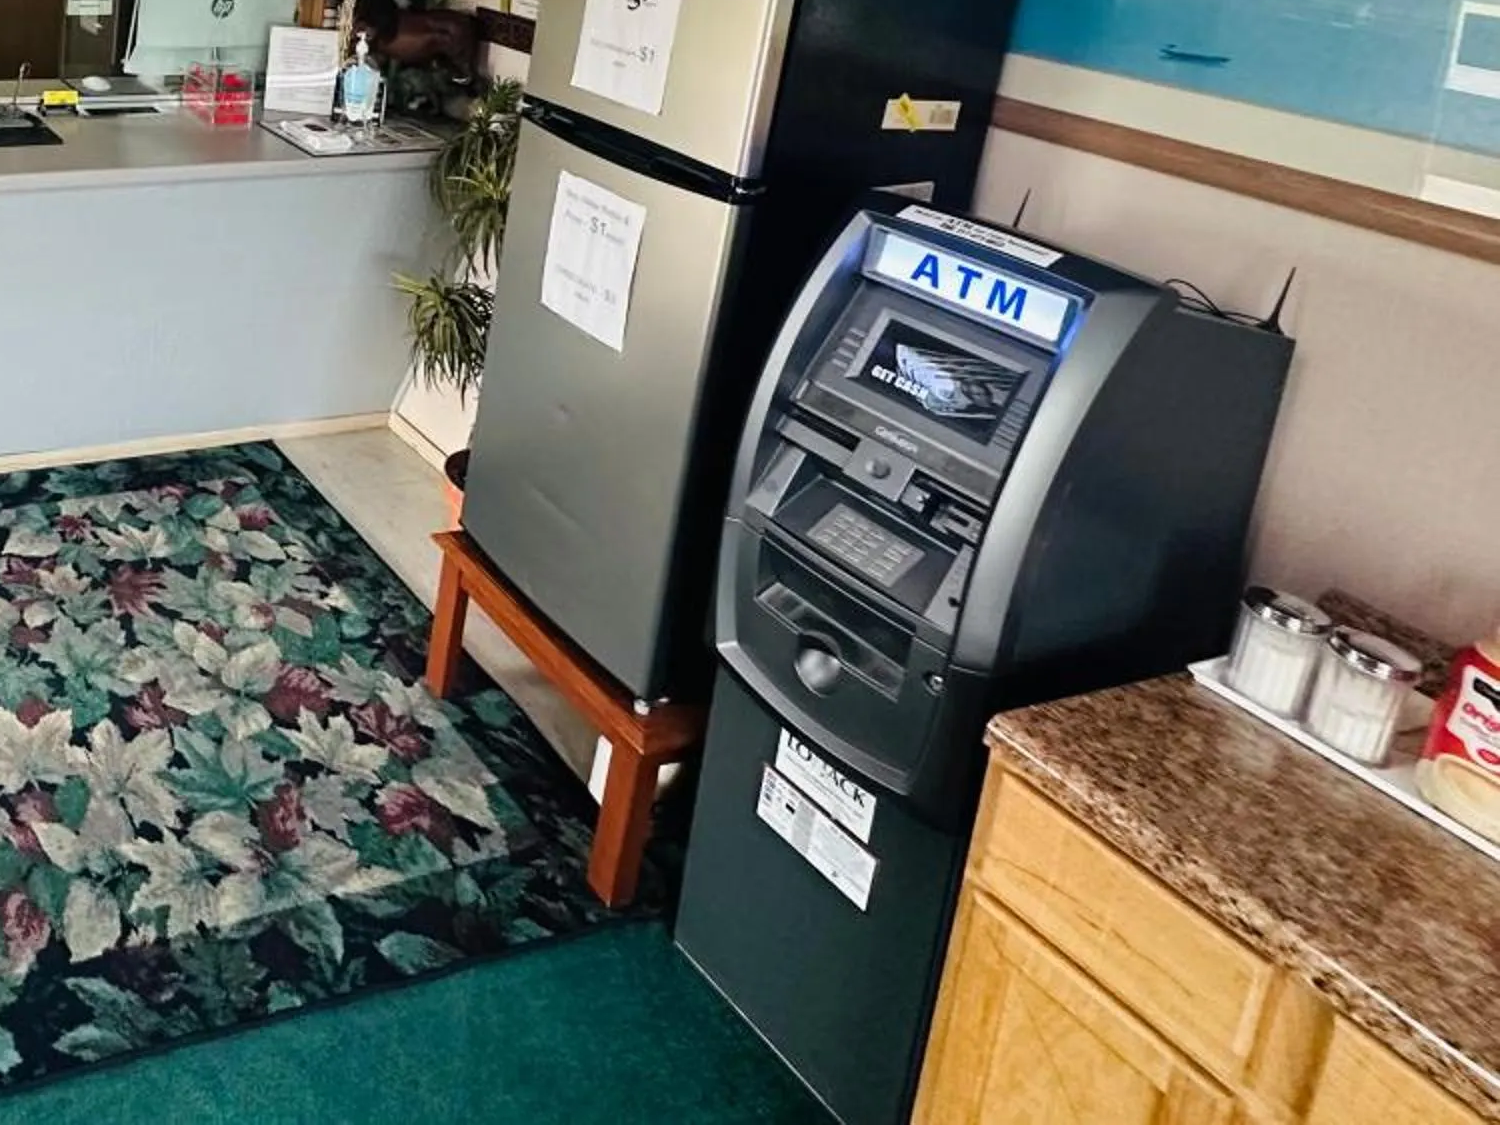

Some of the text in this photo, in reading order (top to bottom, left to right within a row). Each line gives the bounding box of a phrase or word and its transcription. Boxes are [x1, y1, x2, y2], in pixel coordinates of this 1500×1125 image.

[910, 253, 1029, 322] ATM
[871, 364, 929, 400] GET CASH
